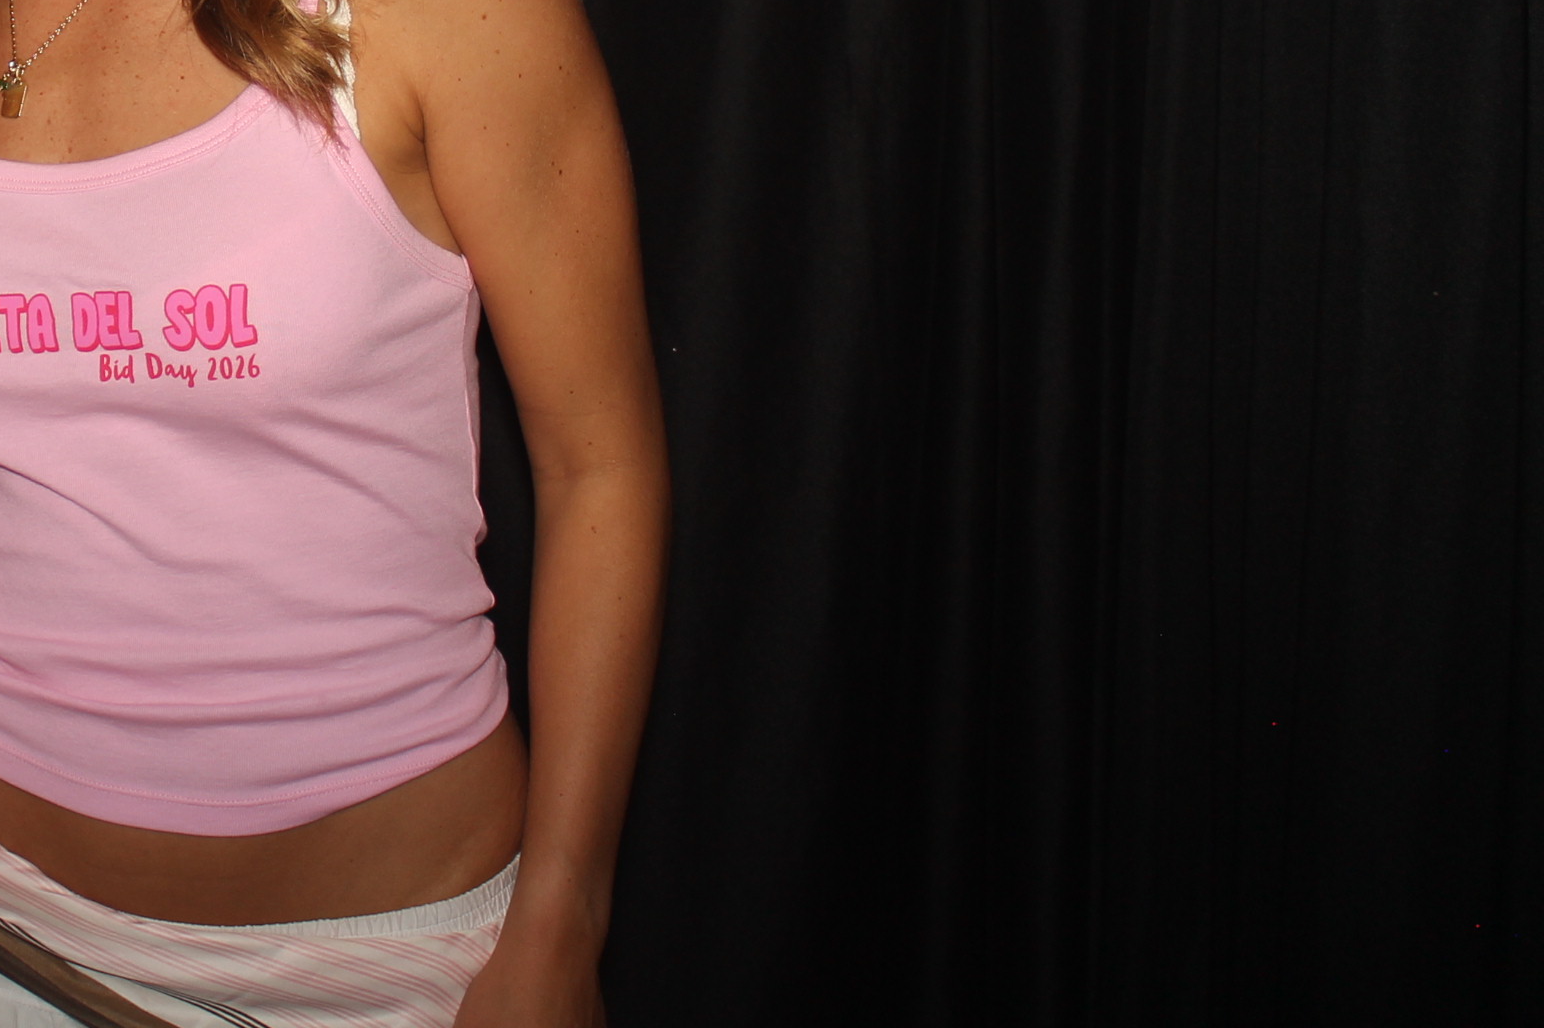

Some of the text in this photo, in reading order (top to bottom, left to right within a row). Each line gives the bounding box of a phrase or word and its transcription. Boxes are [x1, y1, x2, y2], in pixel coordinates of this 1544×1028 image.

[71, 291, 143, 352] DEL
[162, 283, 258, 352] SOL
[99, 353, 260, 388] Bid Day 2026
